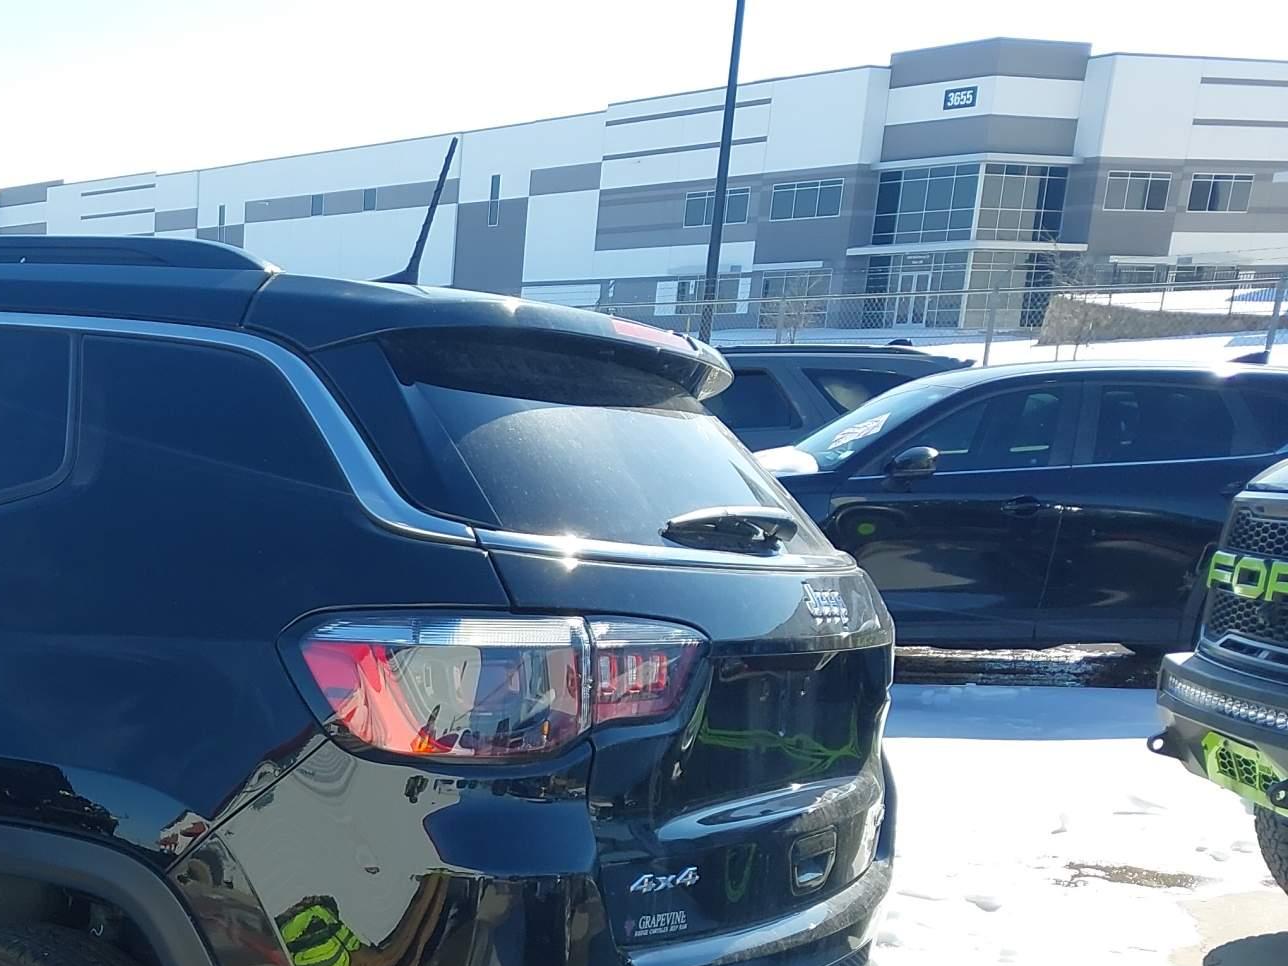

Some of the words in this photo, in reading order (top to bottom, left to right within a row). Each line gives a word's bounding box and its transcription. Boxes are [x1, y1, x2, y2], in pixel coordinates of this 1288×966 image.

[947, 91, 974, 106] 3655
[630, 866, 700, 894] 4x4
[638, 911, 687, 930] GRAPEVINE
